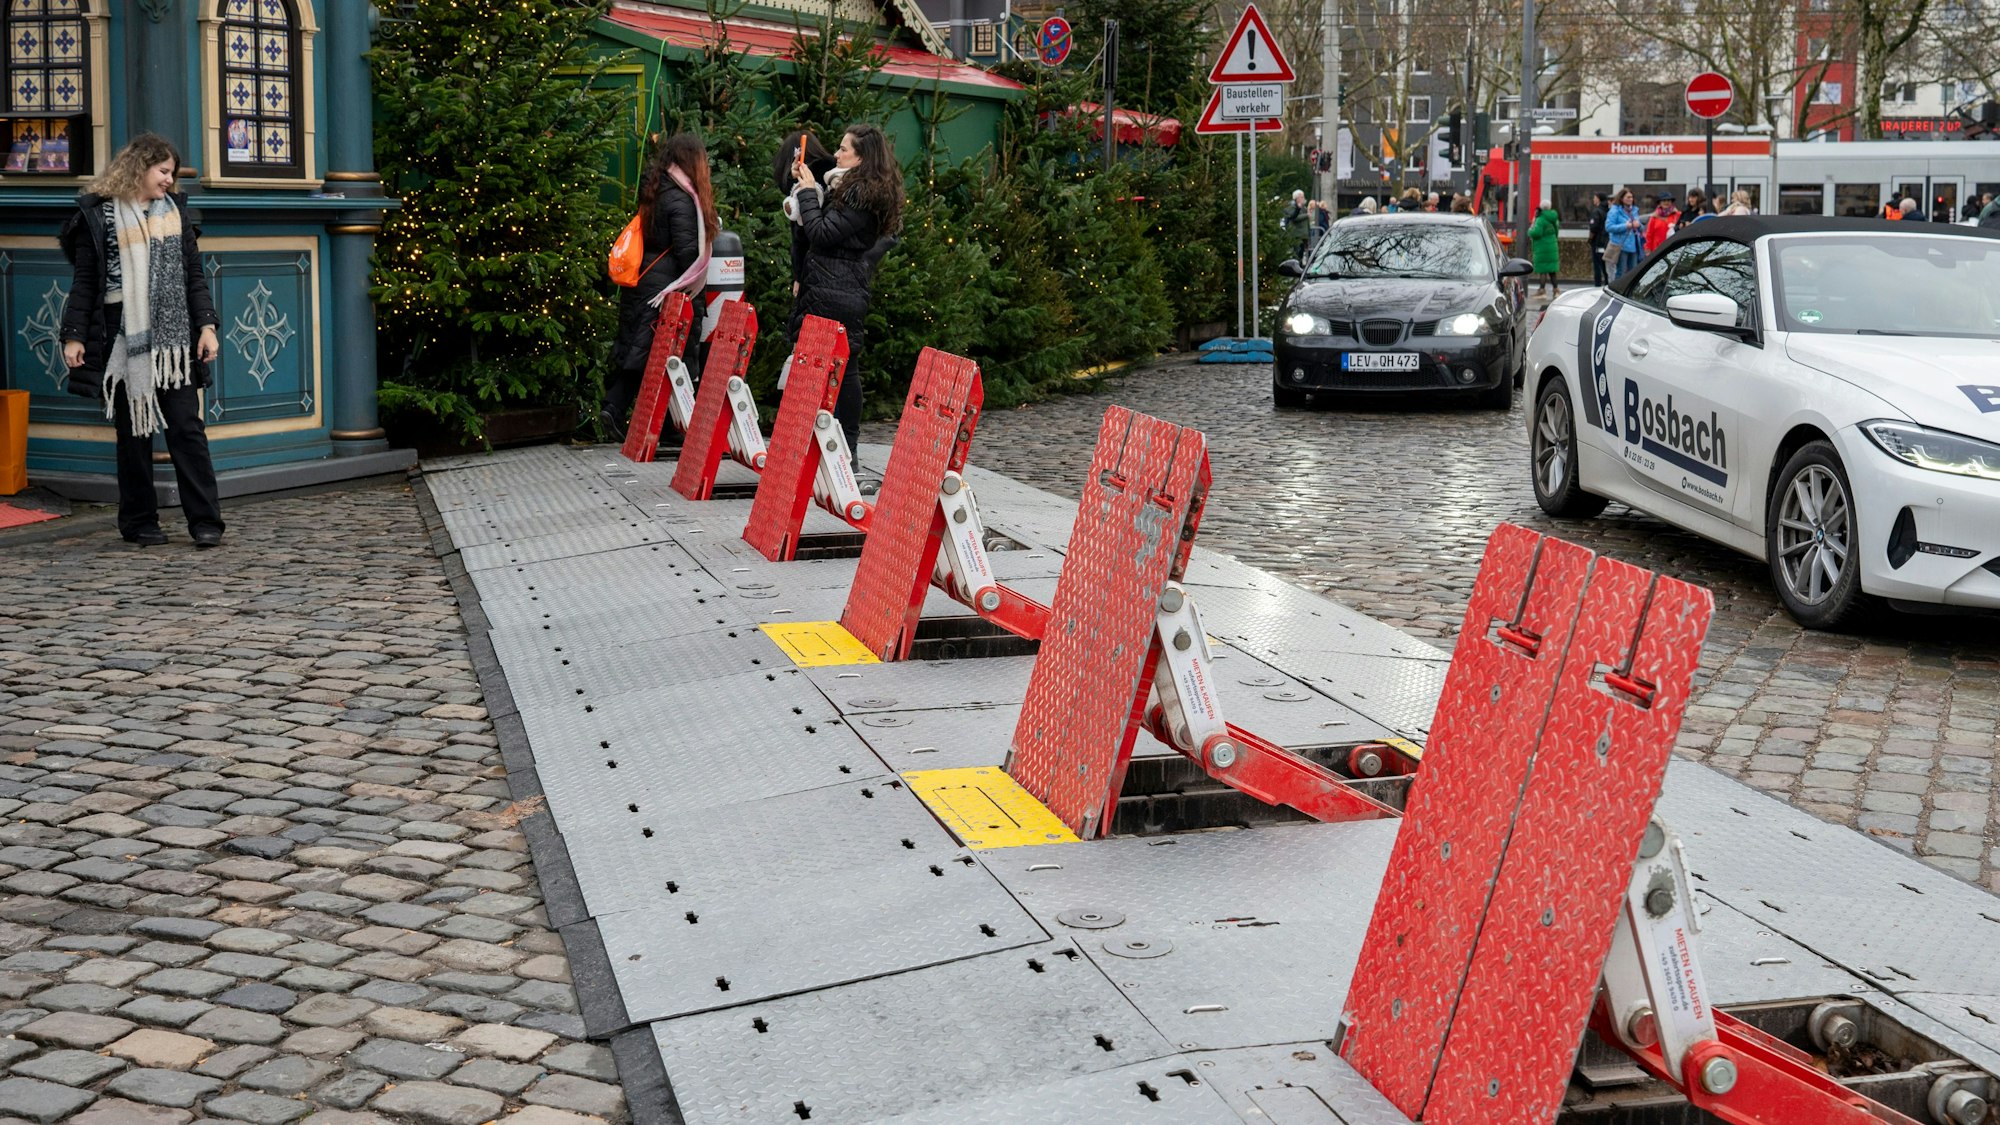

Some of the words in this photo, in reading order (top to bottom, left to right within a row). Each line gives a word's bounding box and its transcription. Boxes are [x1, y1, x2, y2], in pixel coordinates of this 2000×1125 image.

[1226, 87, 1279, 99] Baustellen-
[1235, 102, 1270, 113] verkehr
[1610, 142, 1674, 155] Heumarkt
[1350, 355, 1371, 367] LEV
[1379, 355, 1394, 367] QH
[1397, 355, 1418, 367] 473
[1624, 377, 1727, 469] Bosbach
[1192, 658, 1204, 685] MIETEN
[1203, 692, 1215, 720] KAUFEN
[1675, 928, 1691, 967] MIETEN
[1668, 945, 1688, 1011] zufahrtssperre.de
[1684, 969, 1693, 977] &
[1687, 978, 1703, 1019] KAUFEN
